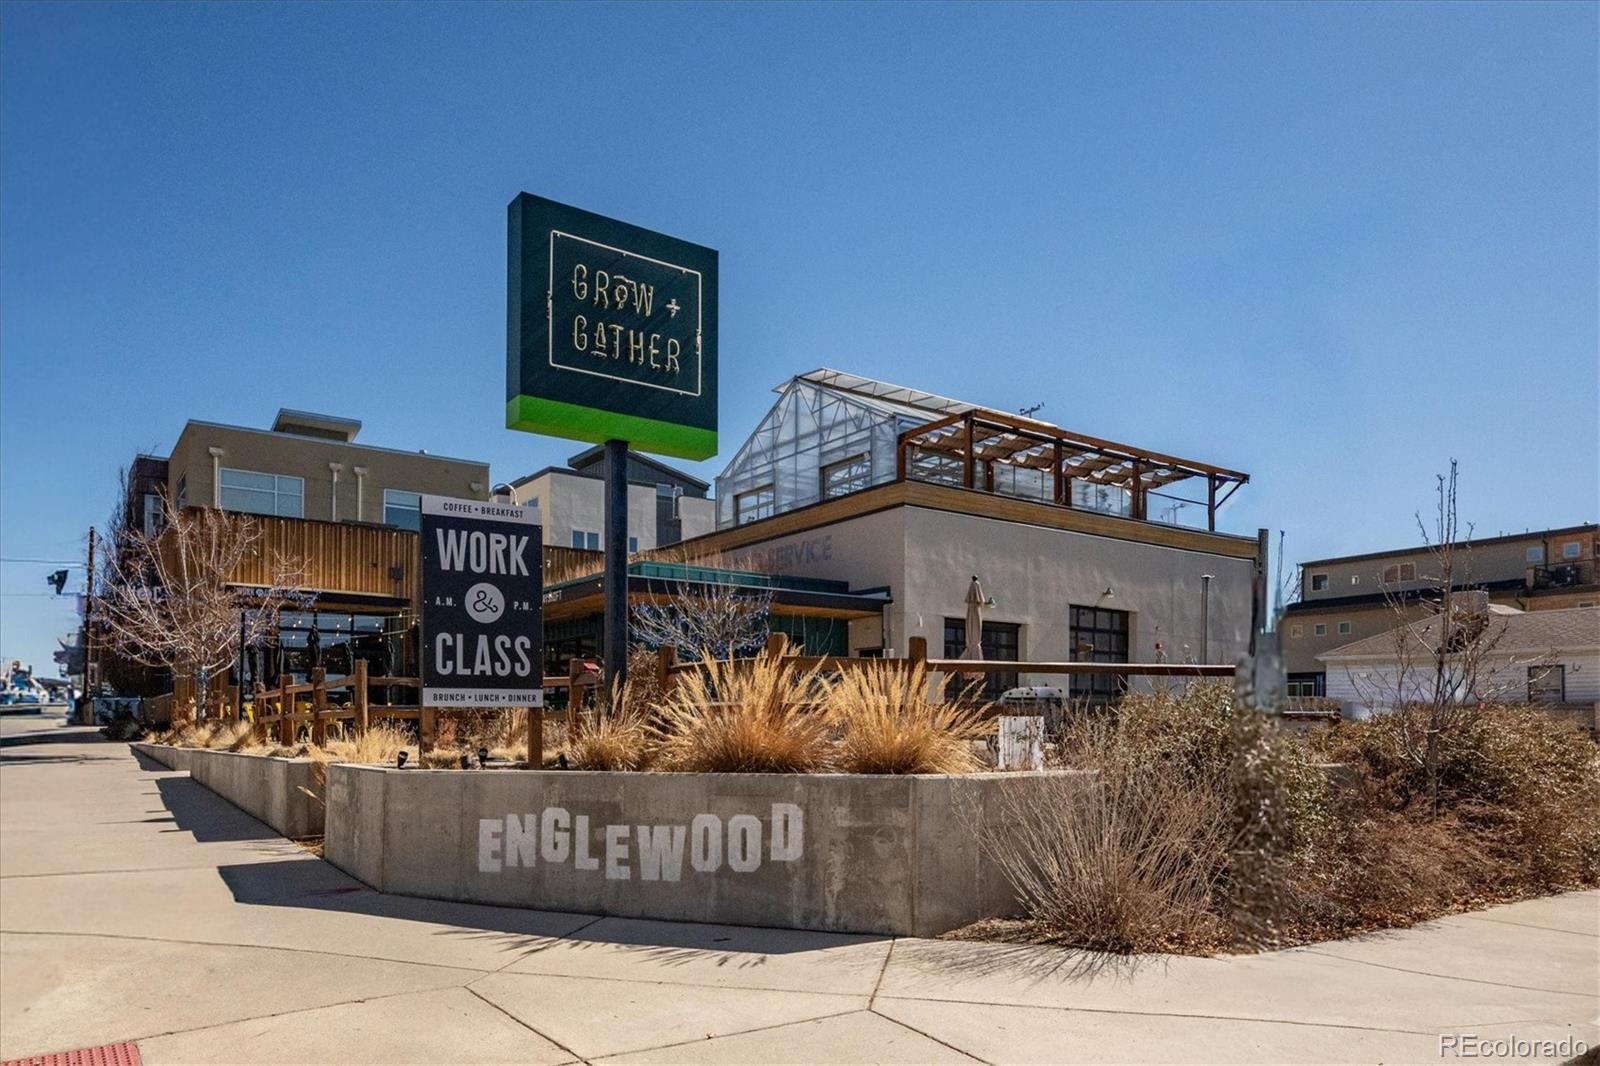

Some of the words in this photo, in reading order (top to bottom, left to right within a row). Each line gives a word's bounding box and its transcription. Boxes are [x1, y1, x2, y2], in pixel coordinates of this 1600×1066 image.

[573, 263, 654, 317] GROW
[573, 314, 681, 375] GATHER
[443, 502, 472, 514] COFFEE
[481, 506, 524, 519] BREAKFAST
[435, 527, 530, 577] WORK
[435, 596, 457, 607] A.M.
[513, 601, 533, 611] P.M.
[435, 632, 531, 677] CLASS
[433, 693, 466, 702] BRUNCH
[474, 694, 500, 702] LUNCH
[508, 694, 537, 703] DINNER
[478, 802, 804, 882] ENGLEWOOD
